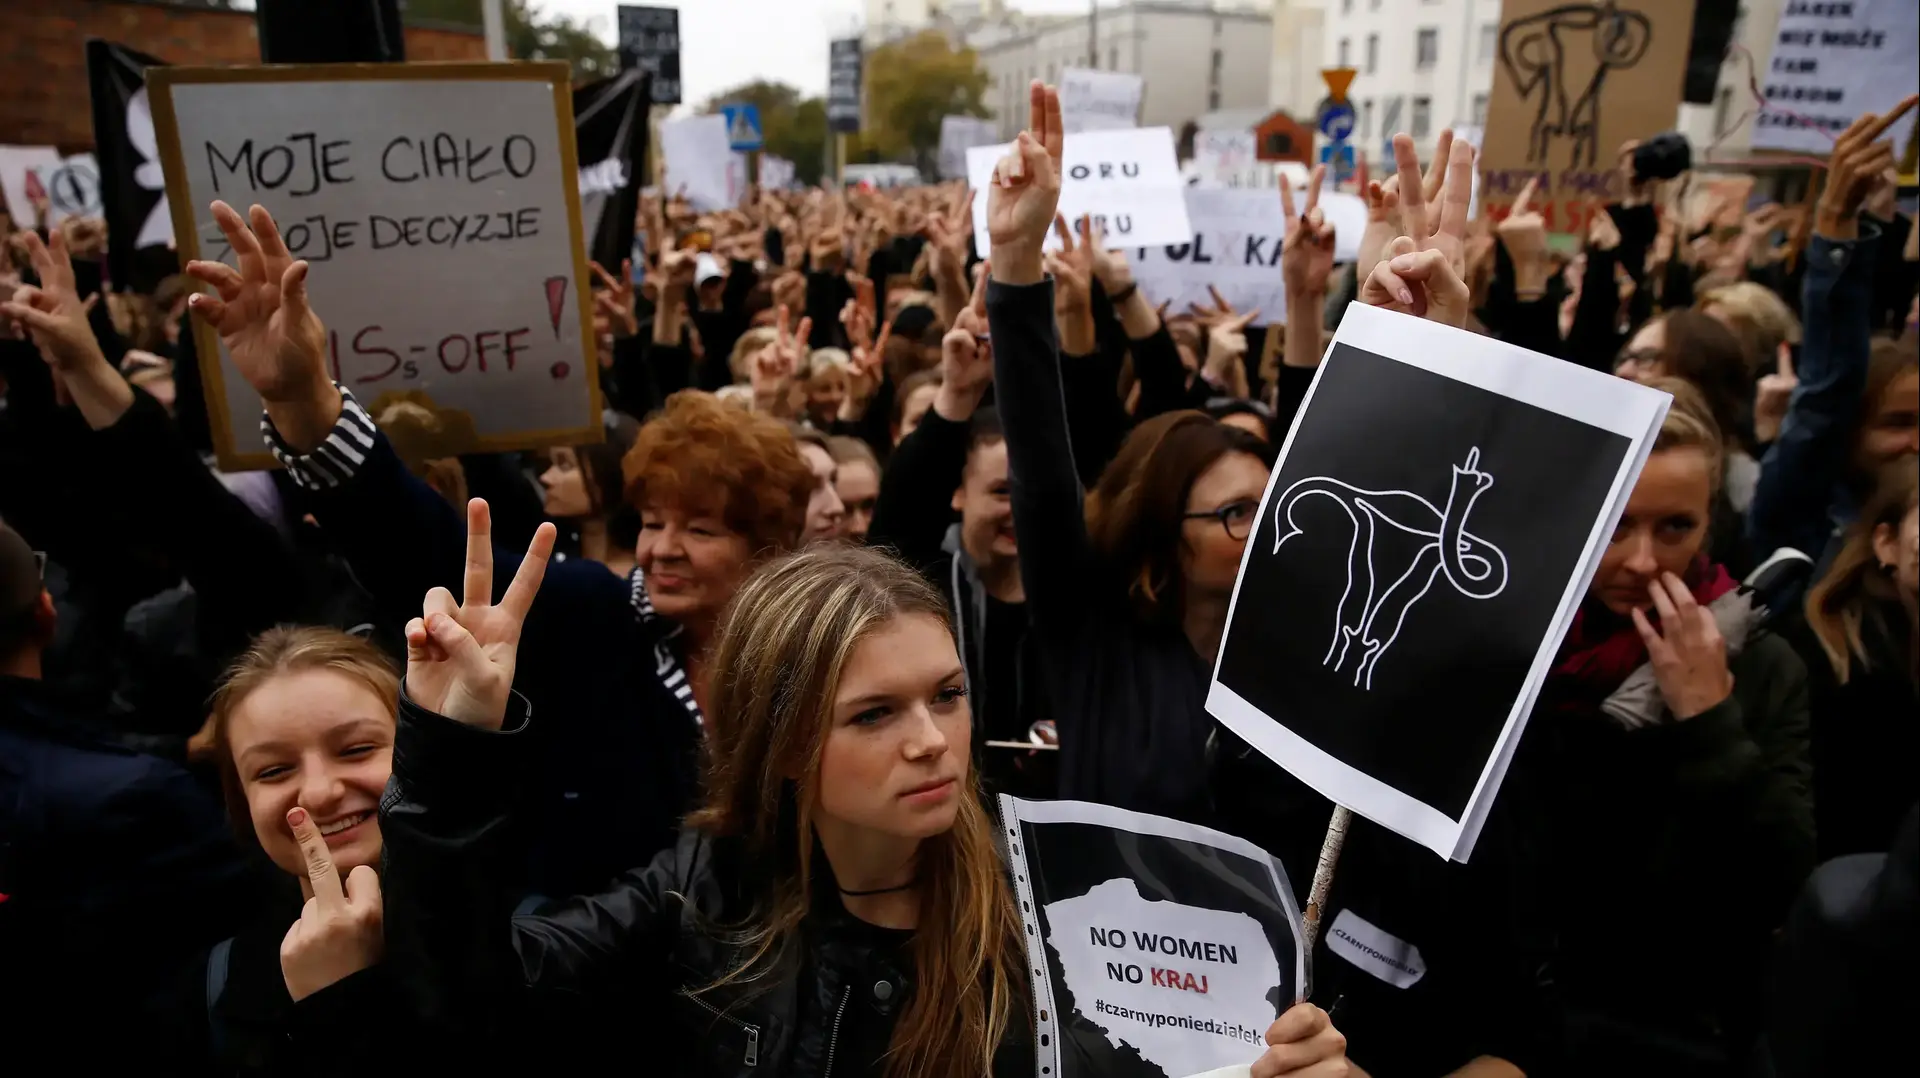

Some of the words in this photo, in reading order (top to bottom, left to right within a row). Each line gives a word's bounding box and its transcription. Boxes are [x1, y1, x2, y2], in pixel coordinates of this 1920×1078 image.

[205, 133, 355, 196] MOJE
[381, 133, 536, 183] CIAŁO
[1070, 162, 1139, 180] ORU
[247, 214, 361, 261] OJE
[370, 208, 541, 250] DECYZJE
[1089, 926, 1127, 949] NO
[1132, 931, 1238, 964] WOMEN
[1106, 962, 1144, 984] NO
[1150, 967, 1209, 994] KRAJ
[1095, 998, 1262, 1046] #czarnyponiedziałek
